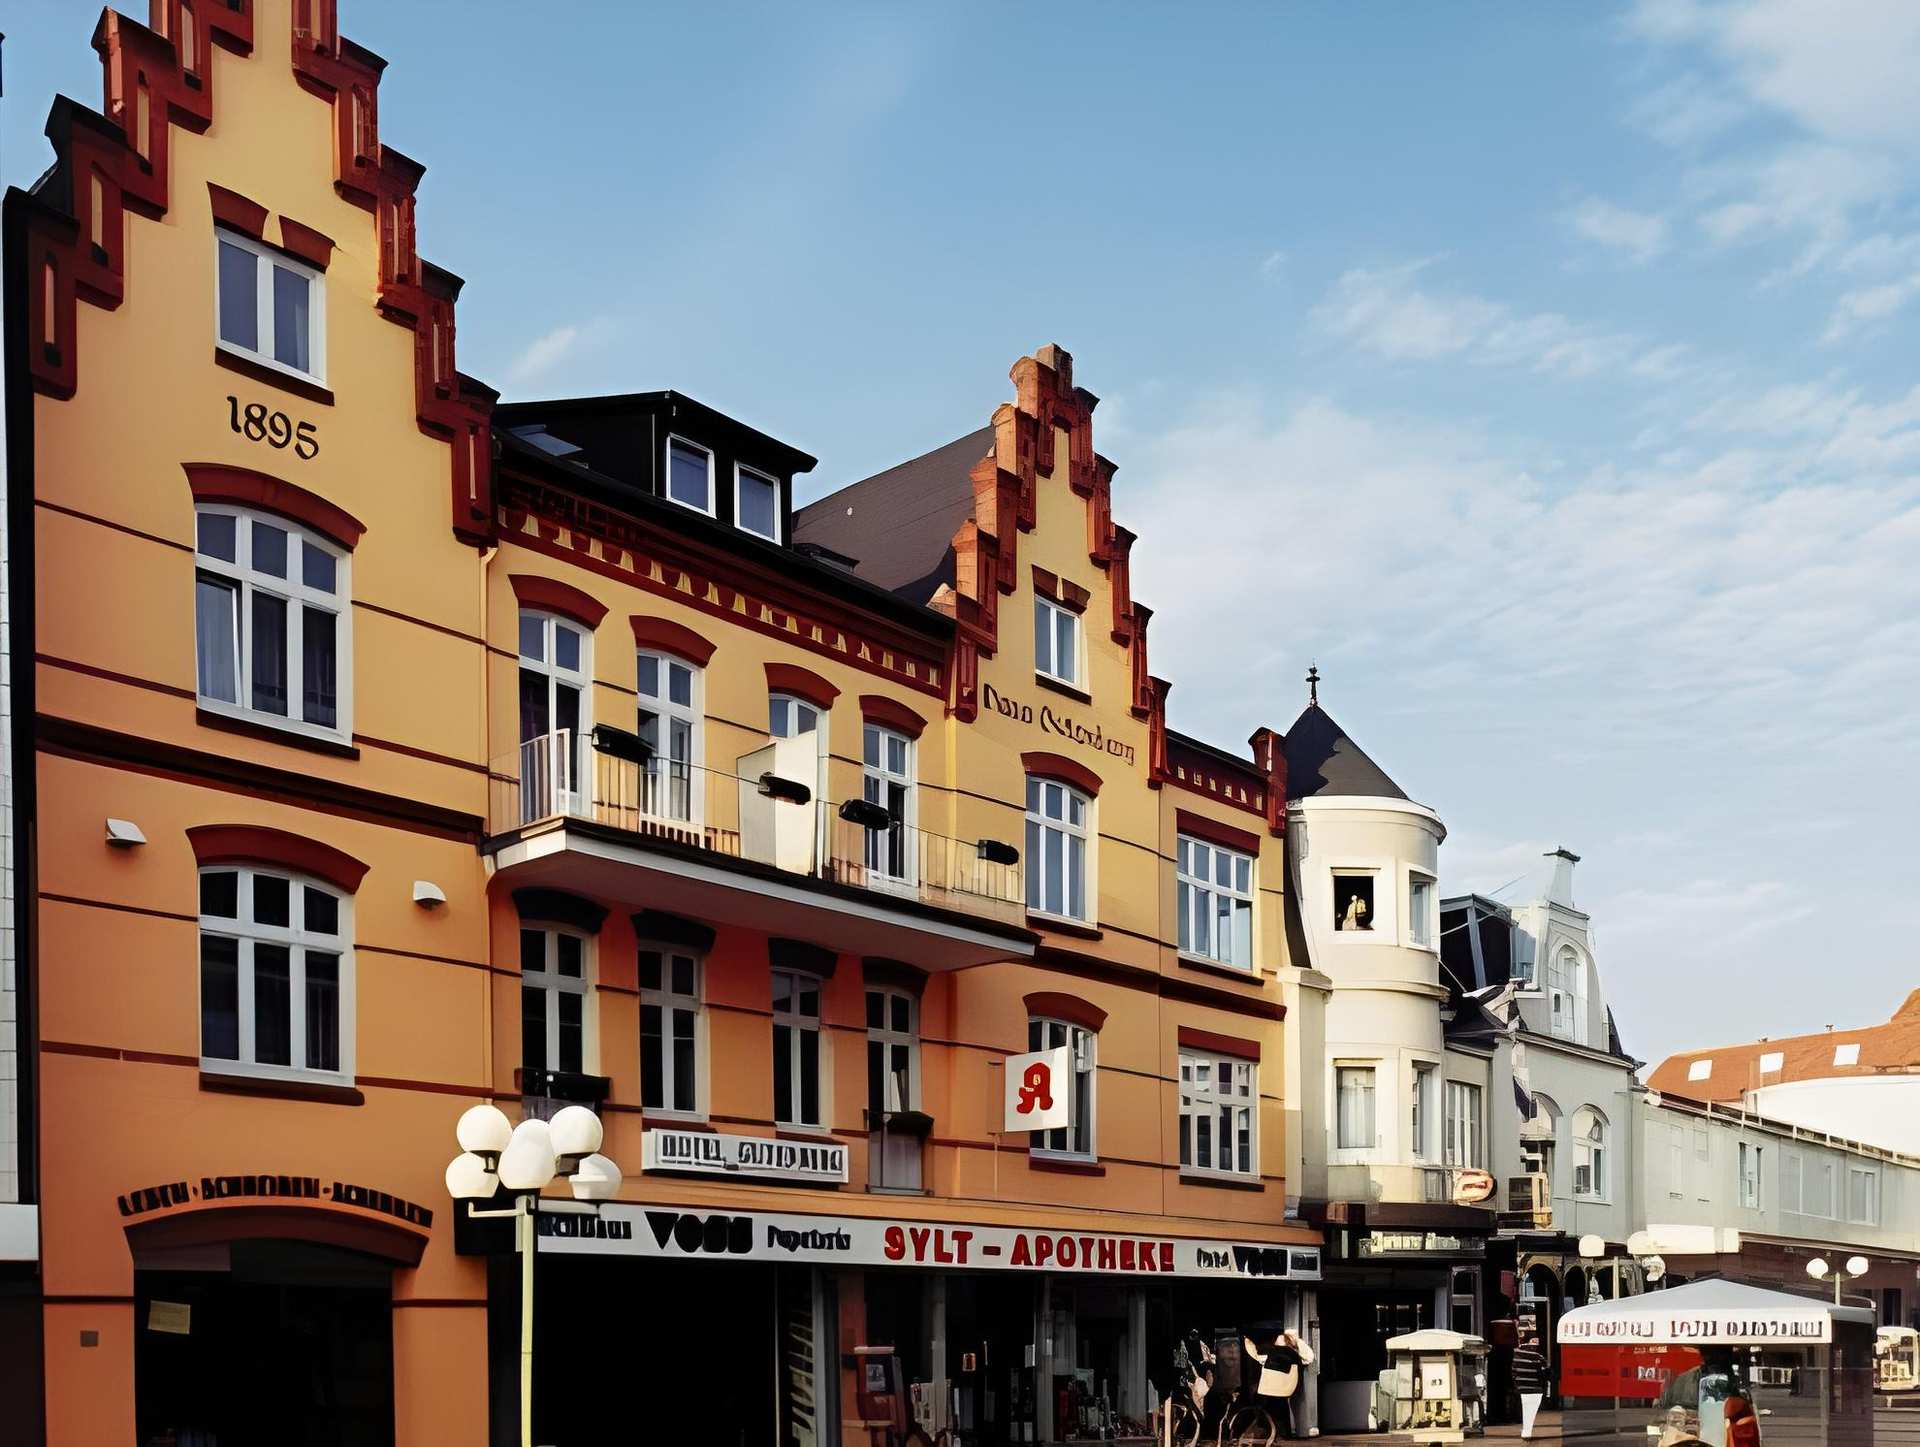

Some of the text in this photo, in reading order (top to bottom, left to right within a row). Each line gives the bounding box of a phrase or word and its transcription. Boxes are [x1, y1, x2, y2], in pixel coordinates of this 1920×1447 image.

[226, 395, 319, 460] 1895
[884, 1225, 973, 1265] SYLT
[1010, 1233, 1176, 1273] APOTHEKE
